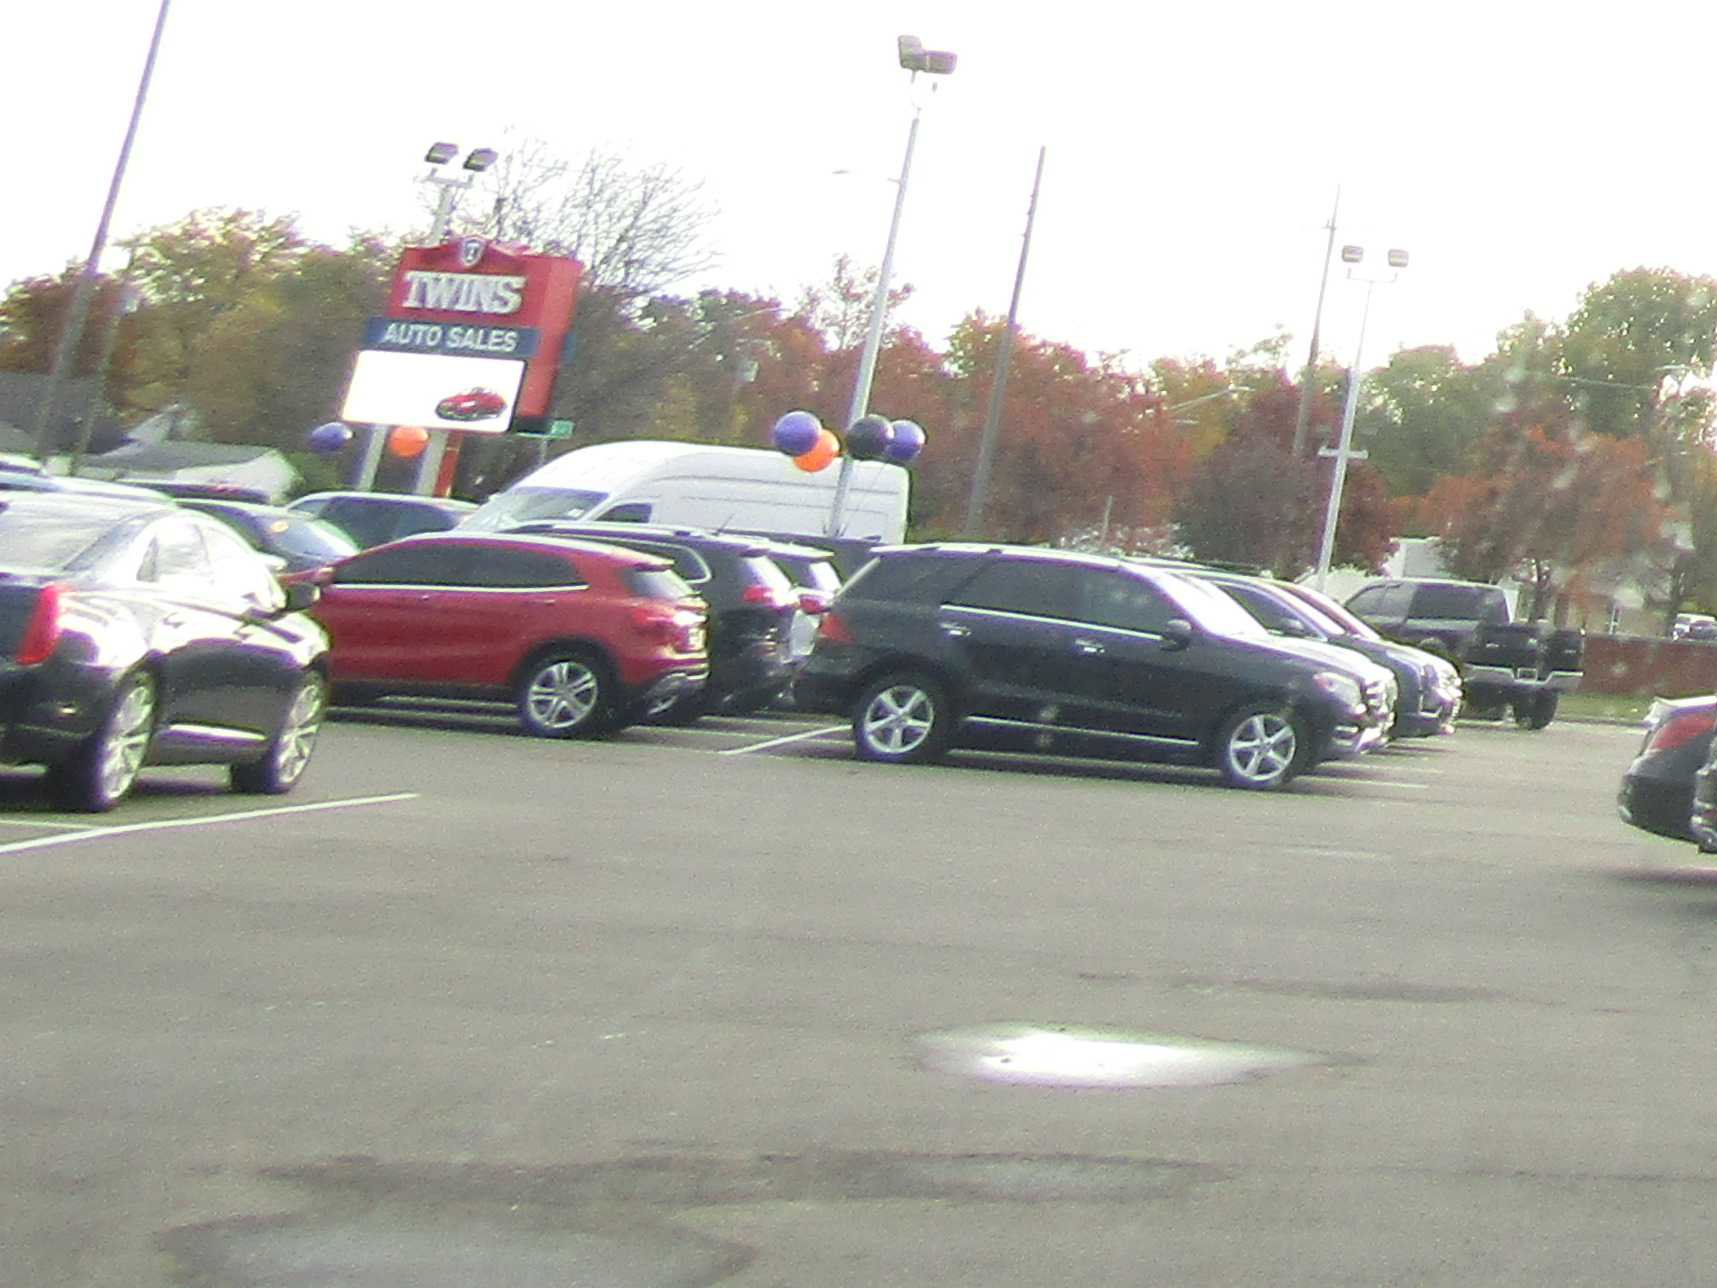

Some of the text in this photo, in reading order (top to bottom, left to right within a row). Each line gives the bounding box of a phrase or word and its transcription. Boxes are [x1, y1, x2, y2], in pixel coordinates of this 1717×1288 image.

[402, 271, 527, 314] TWINS
[382, 323, 518, 352] AUTO SALES
